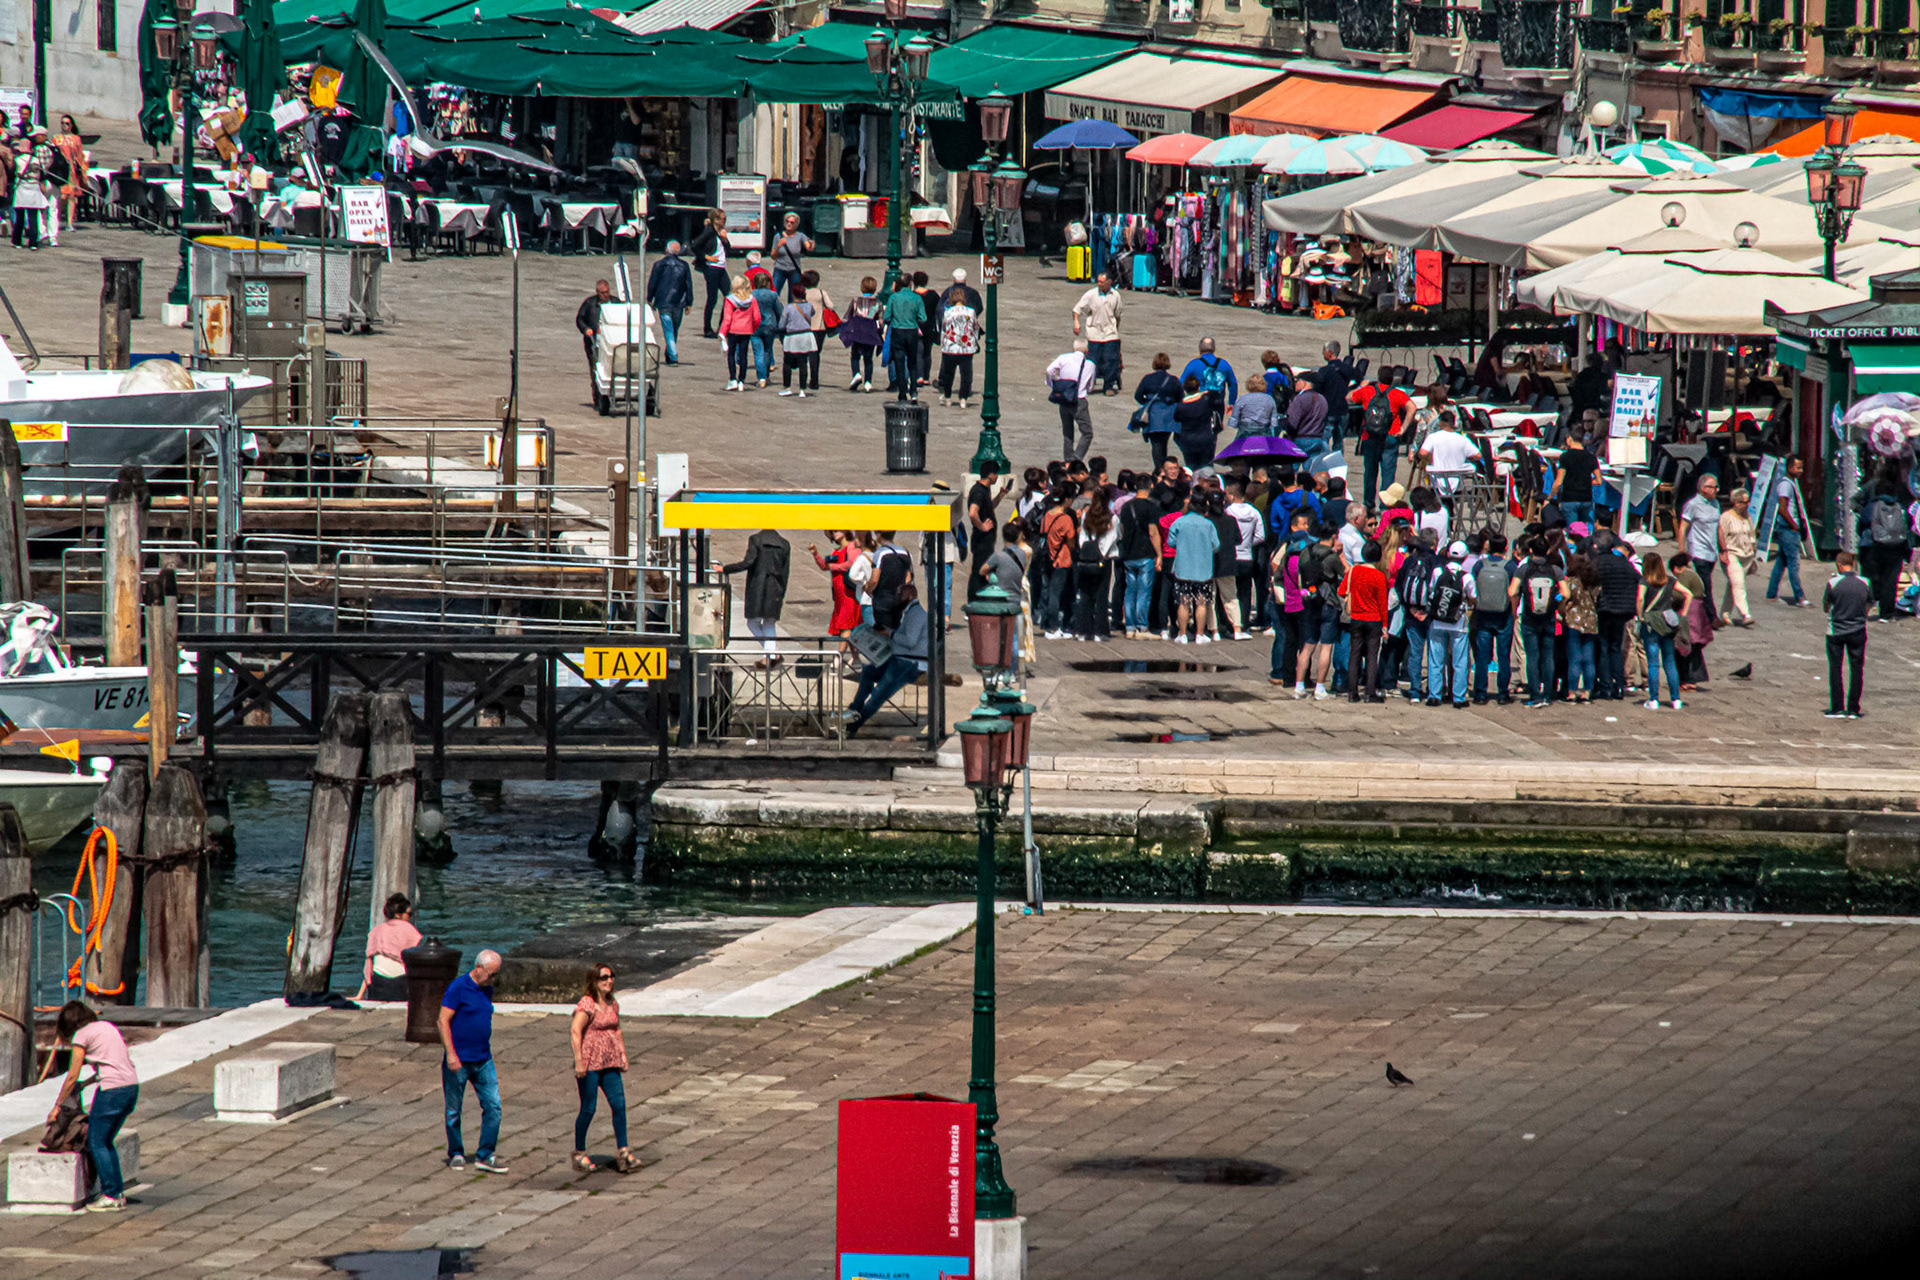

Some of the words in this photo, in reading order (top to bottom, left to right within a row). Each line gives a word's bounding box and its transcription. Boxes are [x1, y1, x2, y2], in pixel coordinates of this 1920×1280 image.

[1069, 102, 1095, 119] SNACK
[1102, 107, 1118, 124] BAR
[1125, 110, 1165, 129] TABACCHI
[984, 266, 1003, 277] WC
[1809, 328, 1846, 338] TICKET
[1847, 327, 1888, 337] OFFICE
[1621, 388, 1641, 396] BAR
[1616, 397, 1644, 406] OPEN
[1616, 407, 1643, 416] DAILY
[592, 651, 661, 676] TAXI
[94, 687, 121, 711] VE
[949, 1124, 960, 1164] Venezia
[948, 1166, 959, 1177] di
[948, 1179, 959, 1224] Biennale
[949, 1225, 959, 1237] La
[858, 1271, 891, 1279] BIENNALE
